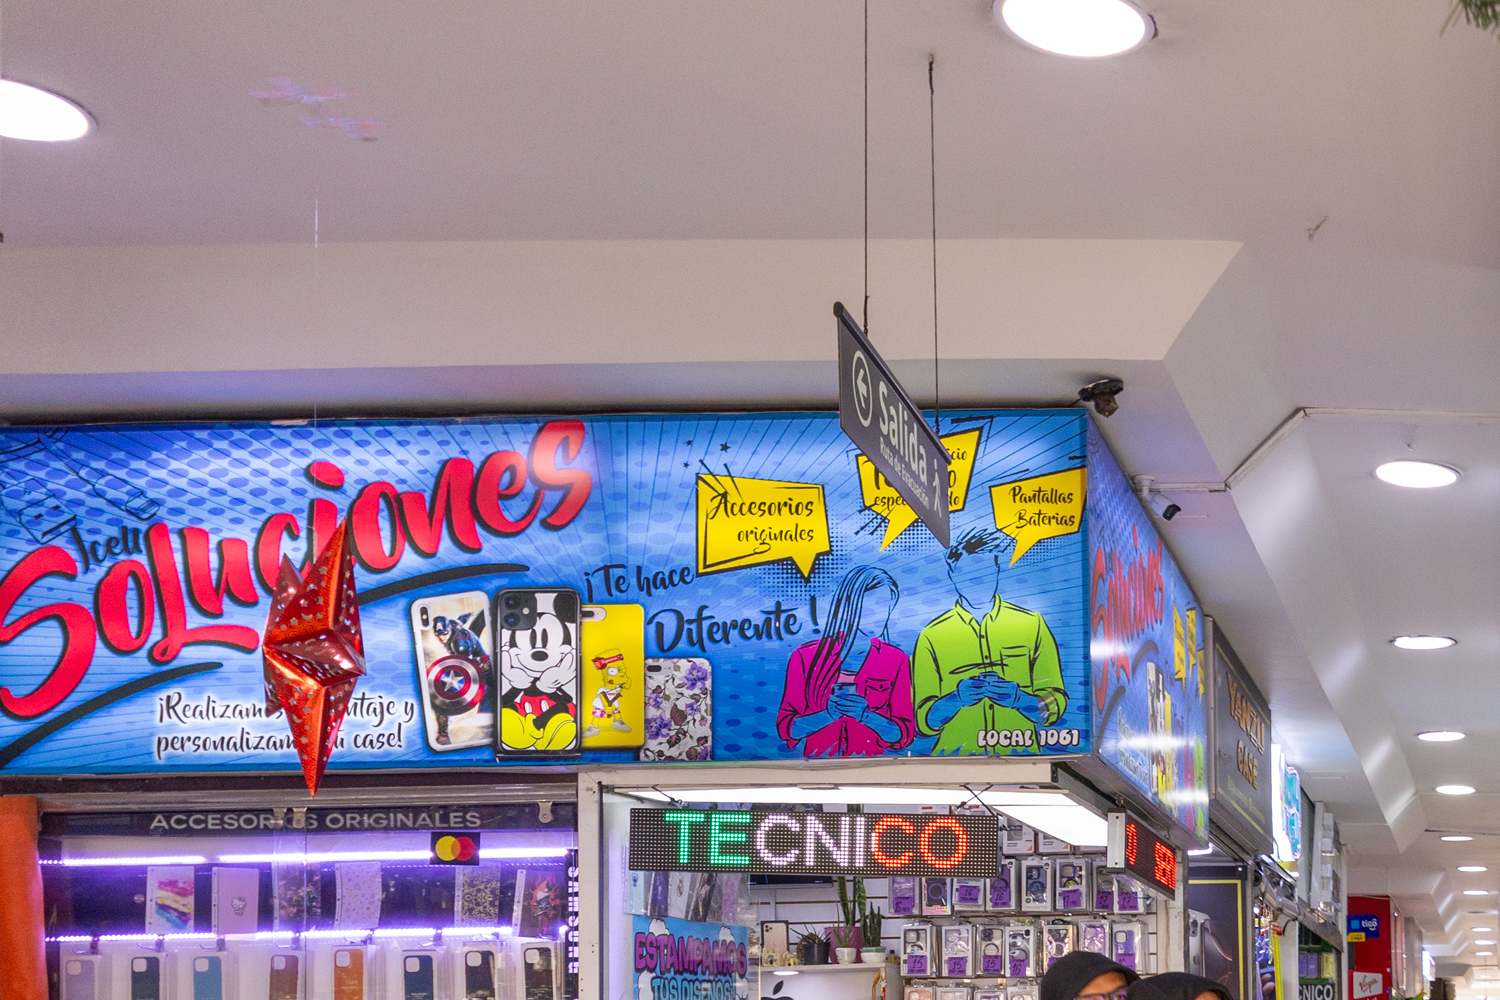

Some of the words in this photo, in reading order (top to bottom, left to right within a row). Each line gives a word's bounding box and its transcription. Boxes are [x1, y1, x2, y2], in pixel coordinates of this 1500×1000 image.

[878, 380, 928, 487] Salida
[879, 436, 894, 464] Ruta
[902, 466, 930, 511] Evacuación
[708, 490, 814, 520] Accesorios
[1009, 485, 1074, 506] Pantallas
[1015, 509, 1076, 529] Baterias
[737, 523, 814, 550] originales
[636, 565, 695, 597] hace
[647, 600, 803, 653] Diferente
[158, 691, 284, 725] ¡Realizams
[346, 691, 399, 727] ntaje
[157, 726, 297, 753] personalizam
[977, 728, 1035, 749] LOCAL
[1038, 728, 1081, 748] 1061
[1236, 739, 1259, 791] CASE
[149, 813, 318, 831] ACCESOROS
[325, 812, 482, 830] ORIGINALES
[664, 810, 969, 870] TECNICO
[567, 866, 580, 974] SAMSUNG
[634, 932, 748, 979] ESTAMPAMOS
